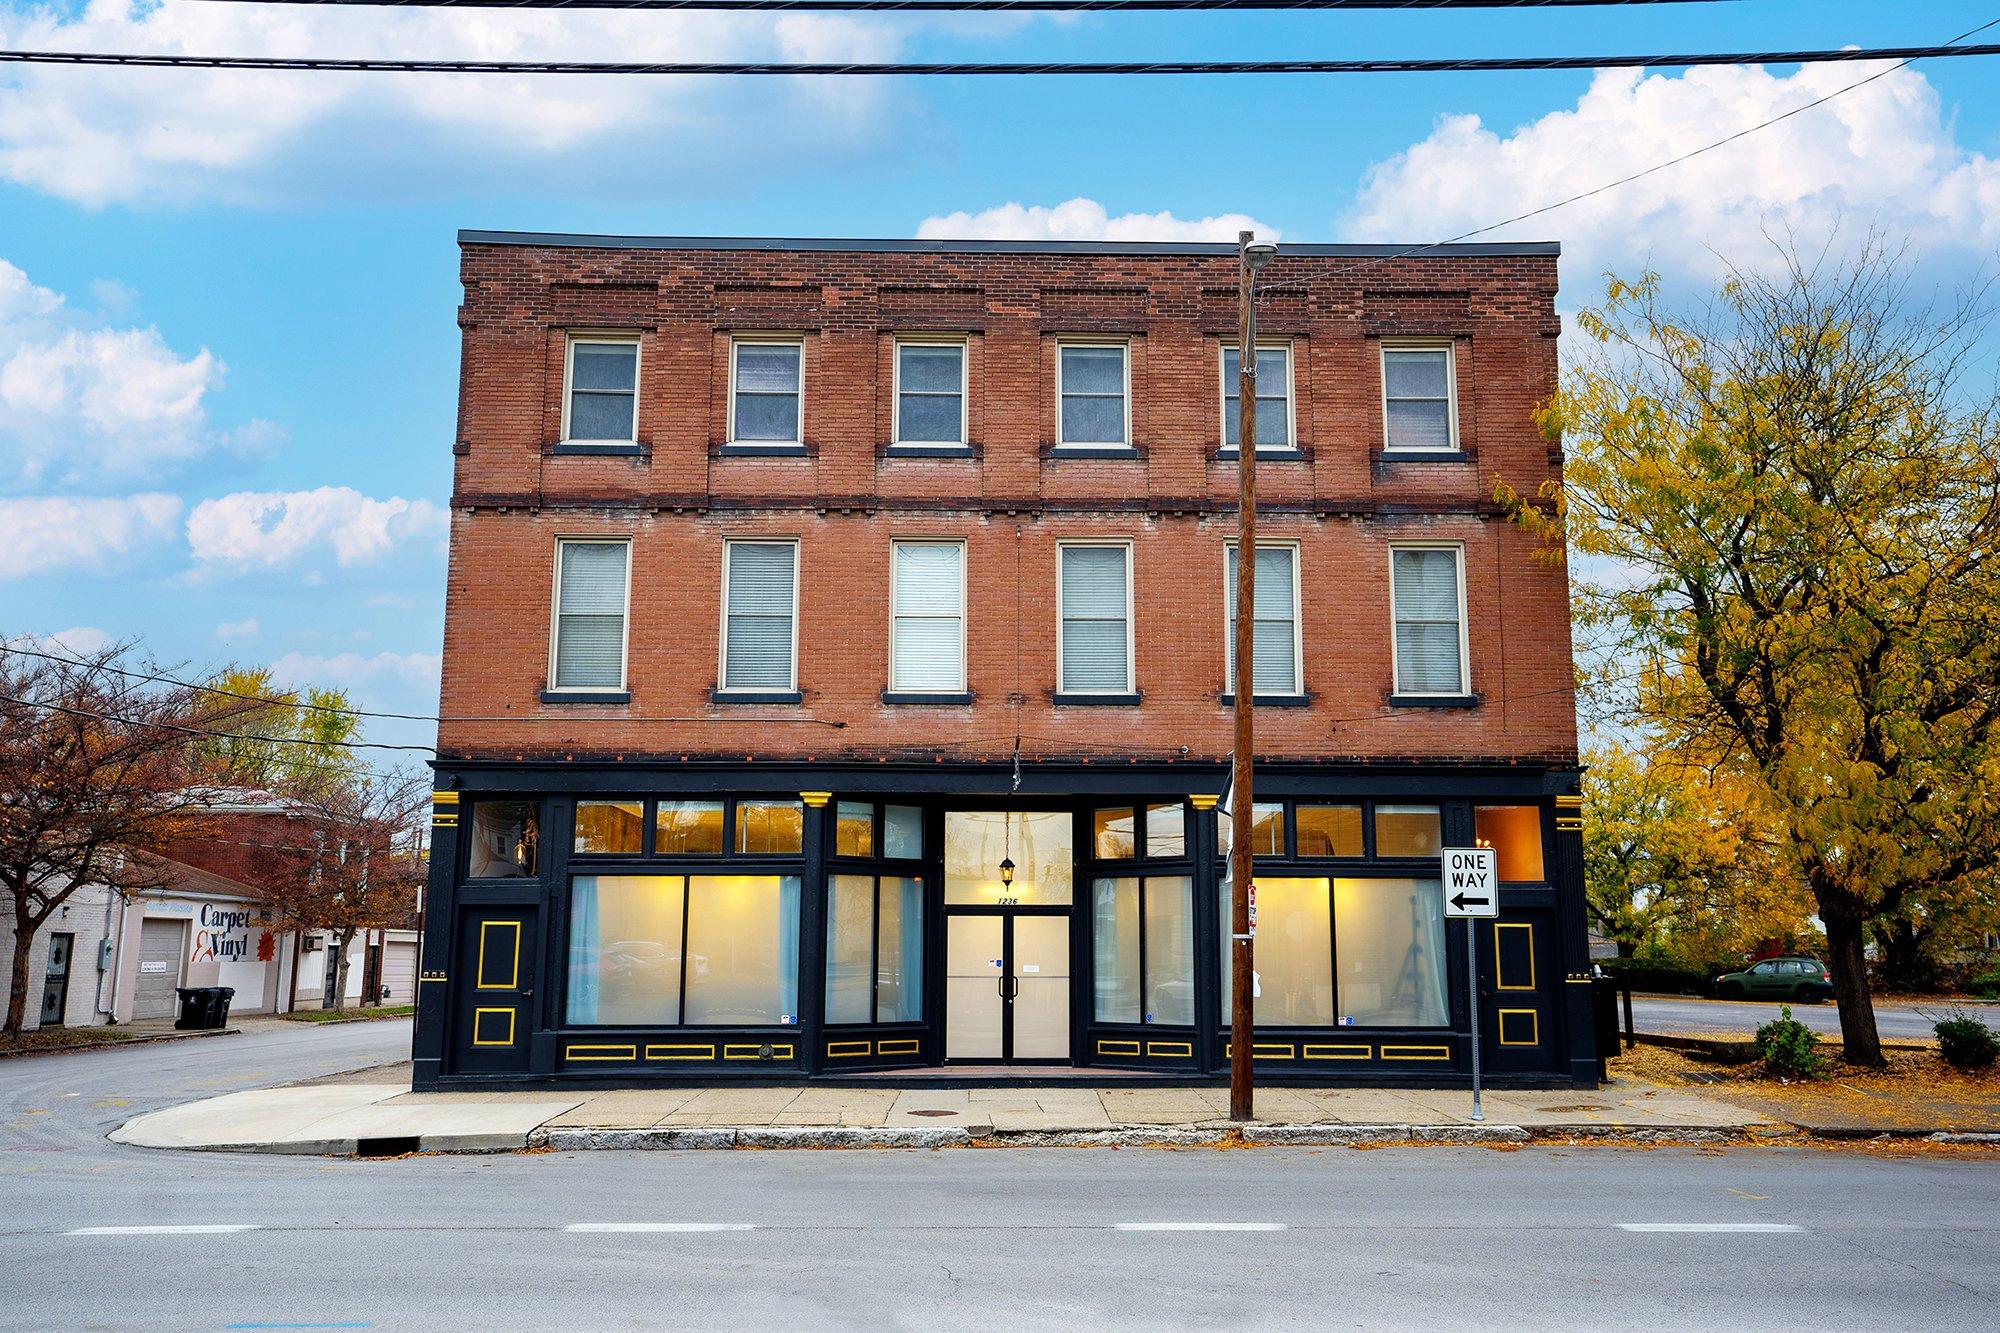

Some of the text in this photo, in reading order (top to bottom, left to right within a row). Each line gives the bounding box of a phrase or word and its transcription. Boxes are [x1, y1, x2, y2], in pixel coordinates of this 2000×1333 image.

[1452, 854, 1487, 870] ONE
[1452, 872, 1488, 888] WAY
[998, 897, 1018, 905] 1236
[201, 903, 250, 933] Carpet
[211, 932, 248, 962] Vinyl
